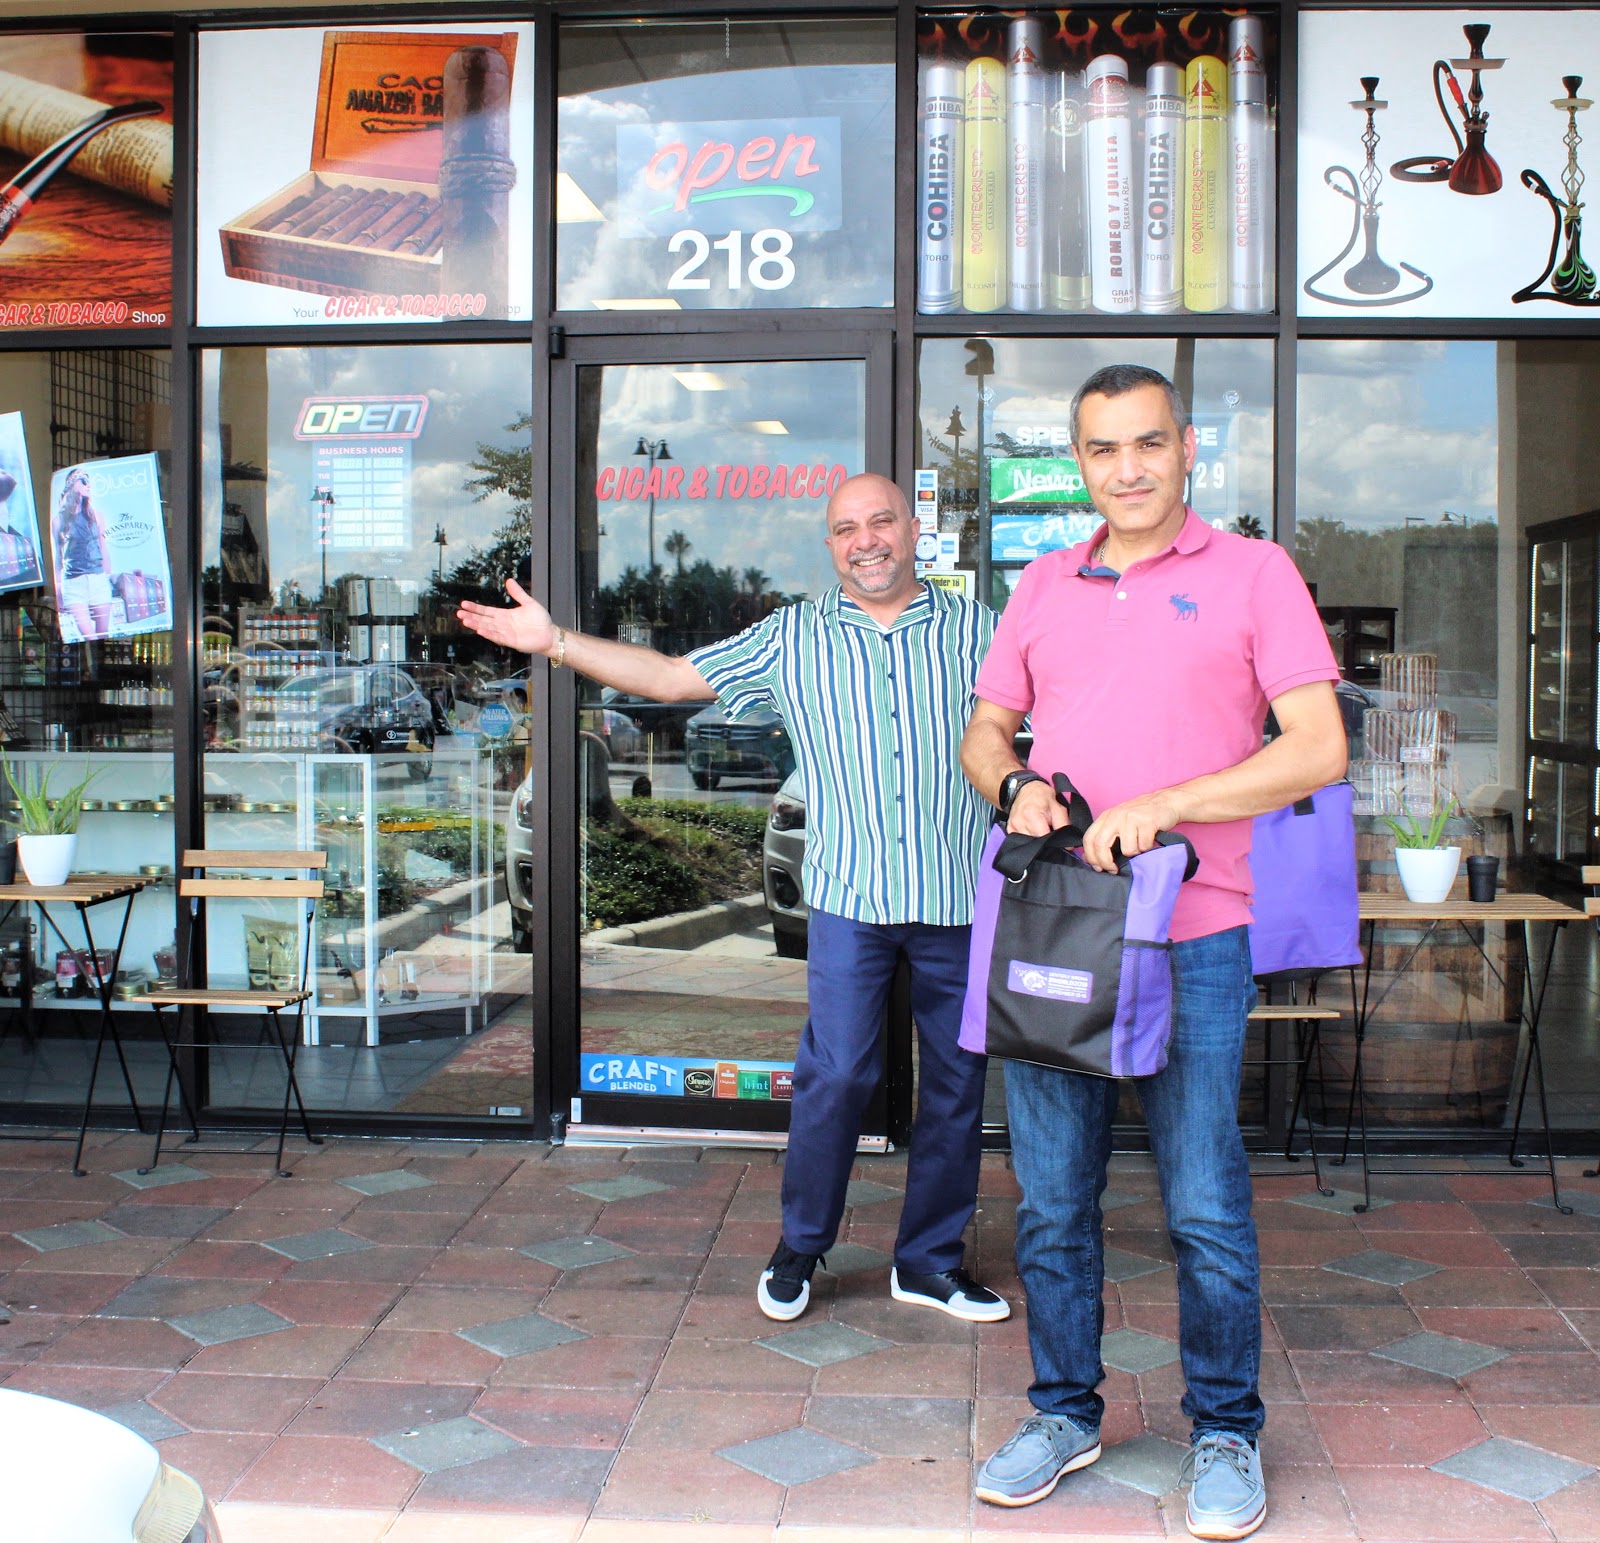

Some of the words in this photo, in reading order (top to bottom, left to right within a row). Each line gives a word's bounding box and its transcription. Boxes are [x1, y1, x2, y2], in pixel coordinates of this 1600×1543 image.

[377, 73, 443, 91] CAO
[645, 133, 820, 212] open
[1107, 135, 1120, 197] JULIETA
[926, 132, 949, 241] COHIBA
[986, 170, 996, 197] SERIES
[1014, 143, 1027, 248] MONTECRISTO
[1121, 176, 1129, 195] REAL
[1147, 131, 1170, 241] COHIBA
[1207, 169, 1216, 197] SERIES
[1235, 143, 1248, 247] MONTECRISTO
[970, 149, 983, 255] MONTECRISTO
[986, 199, 996, 231] CLASSIC
[1108, 204, 1120, 214] Y
[1122, 197, 1130, 230] RESERVA
[1192, 149, 1204, 255] MONTECRISTO
[1207, 199, 1216, 230] CLASSIC
[666, 228, 796, 291] 218
[925, 254, 949, 262] TORO
[1108, 219, 1123, 277] ROMEO
[1145, 253, 1170, 261] TORO
[0, 304, 31, 326] GAR
[31, 303, 46, 326] &
[48, 301, 129, 325] TOBACCO
[131, 310, 166, 325] Shop
[293, 307, 319, 318] Your
[324, 295, 383, 319] CIGAR
[384, 294, 399, 318] &
[400, 293, 487, 317] TOBACCO
[302, 403, 421, 434] OPEN
[319, 446, 368, 455] BUSINESS
[370, 446, 404, 454] HOURS
[1015, 426, 1072, 446] SPE
[595, 465, 684, 501] CIGAR
[687, 465, 710, 500] &
[714, 463, 848, 501] TOBACCO
[1013, 468, 1085, 495] Newp
[101, 521, 155, 539] TRANSPARENT
[120, 512, 134, 523] The
[588, 1058, 678, 1088] CRAFT
[610, 1081, 657, 1093] BLENDED
